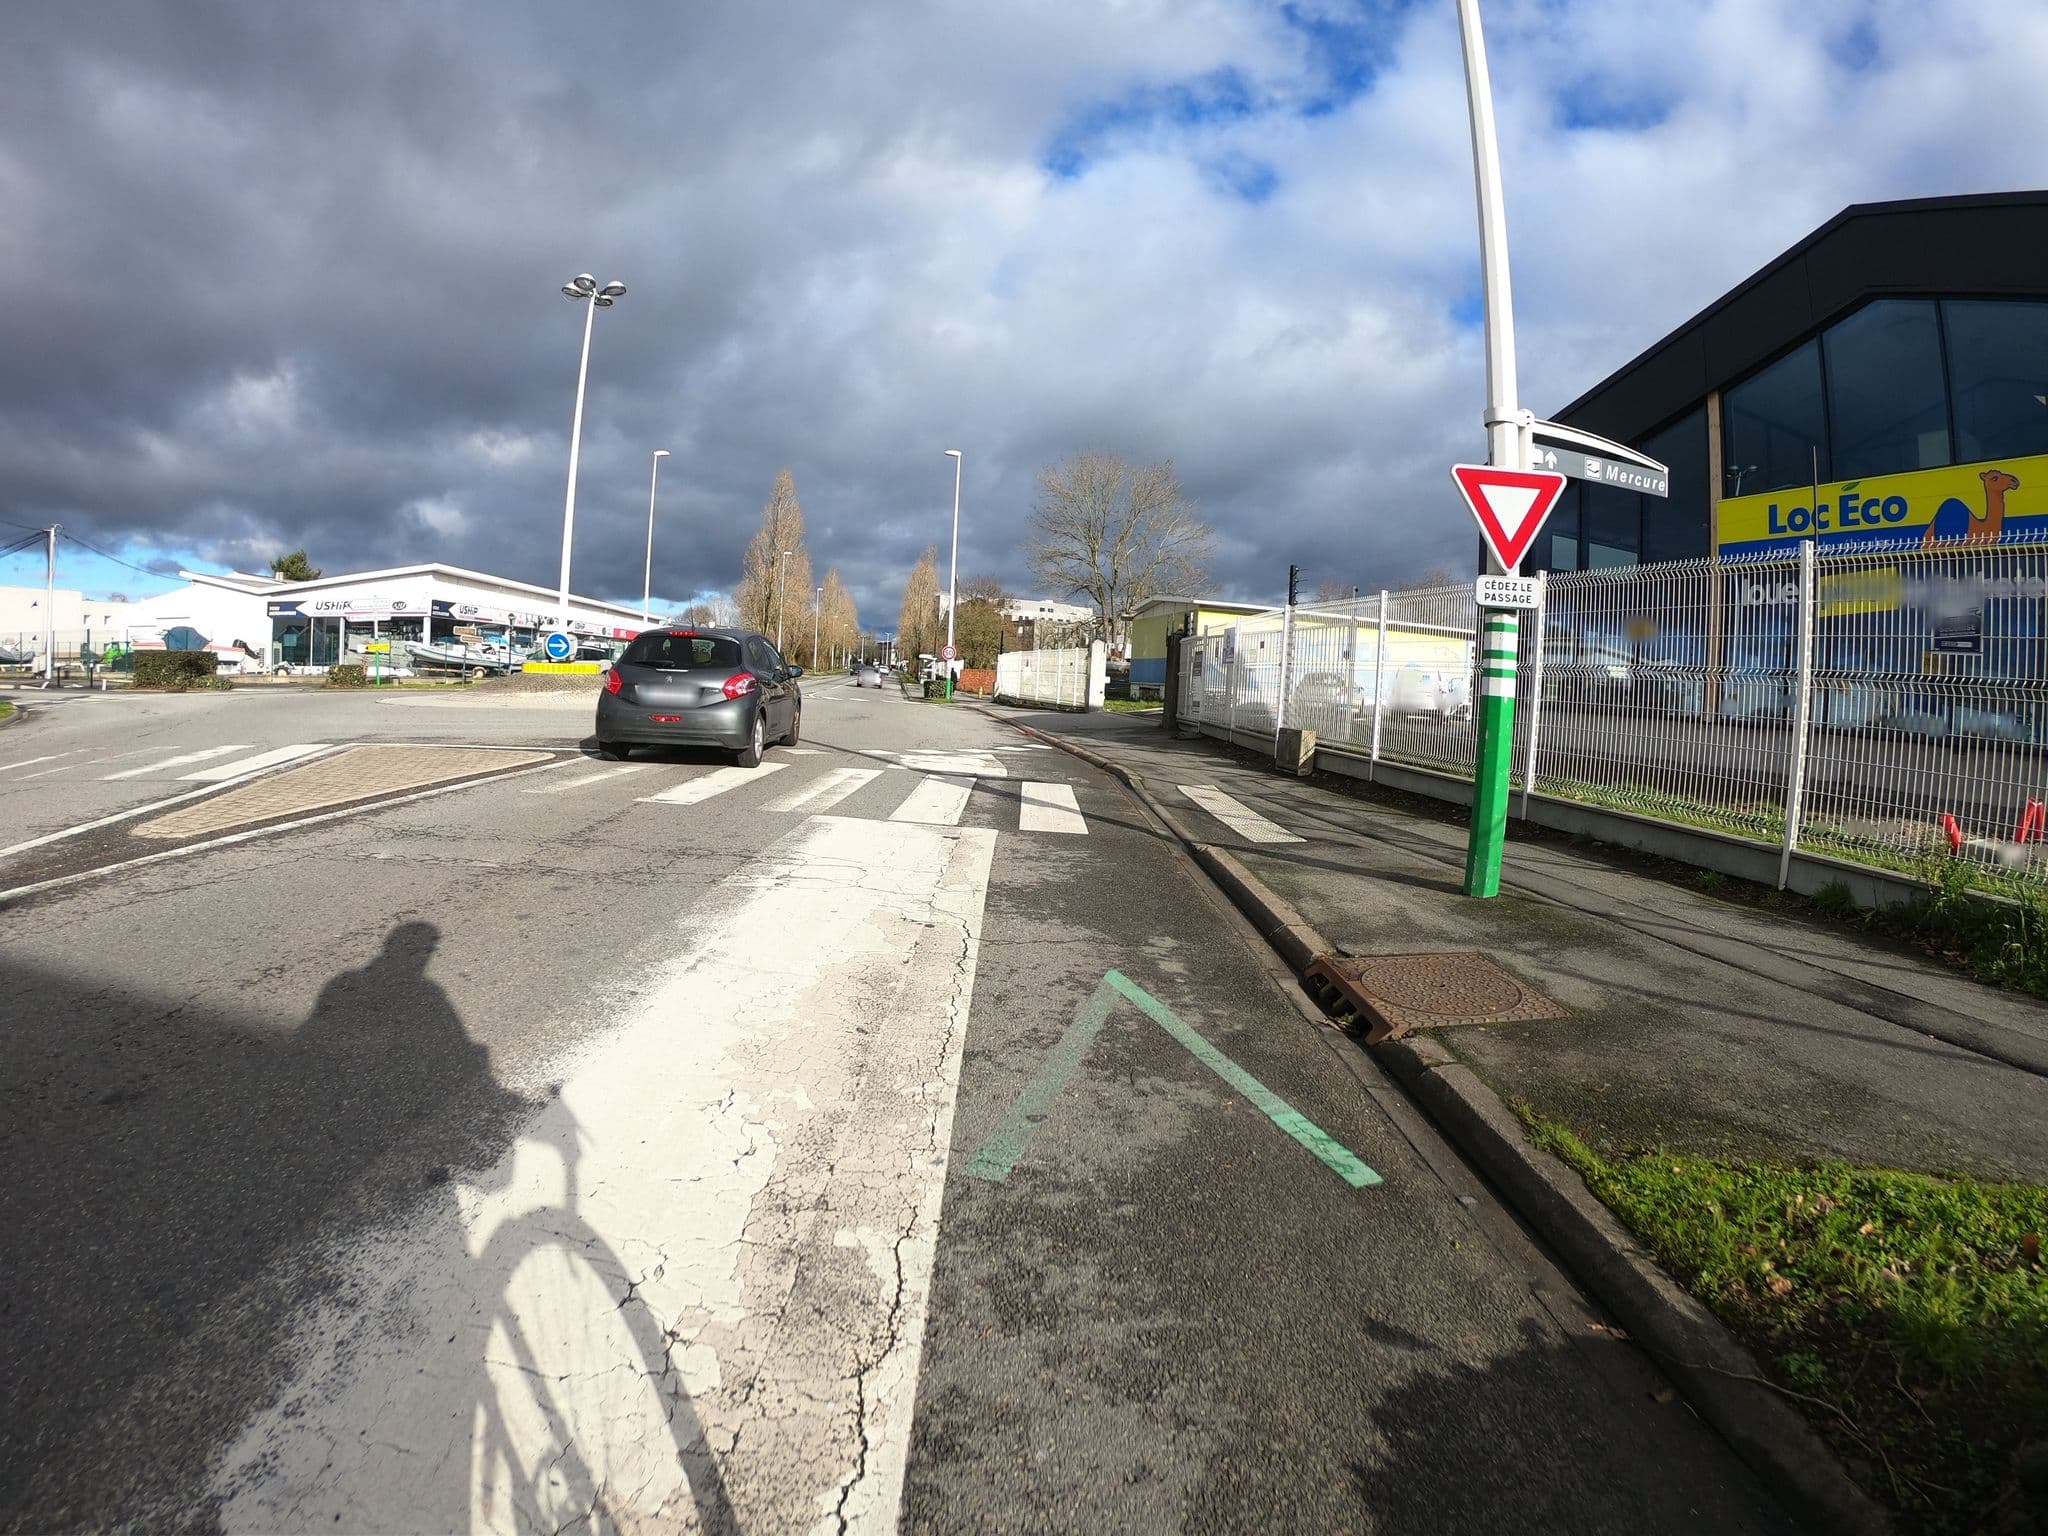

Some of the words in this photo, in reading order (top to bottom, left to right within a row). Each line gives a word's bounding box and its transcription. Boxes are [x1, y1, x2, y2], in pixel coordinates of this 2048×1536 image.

[1606, 465, 1666, 492] Mercure
[1768, 504, 1829, 534] Loc
[1484, 579, 1518, 592] CÉDEZ
[1520, 583, 1533, 593] LE
[1484, 593, 1532, 604] PASSAGE
